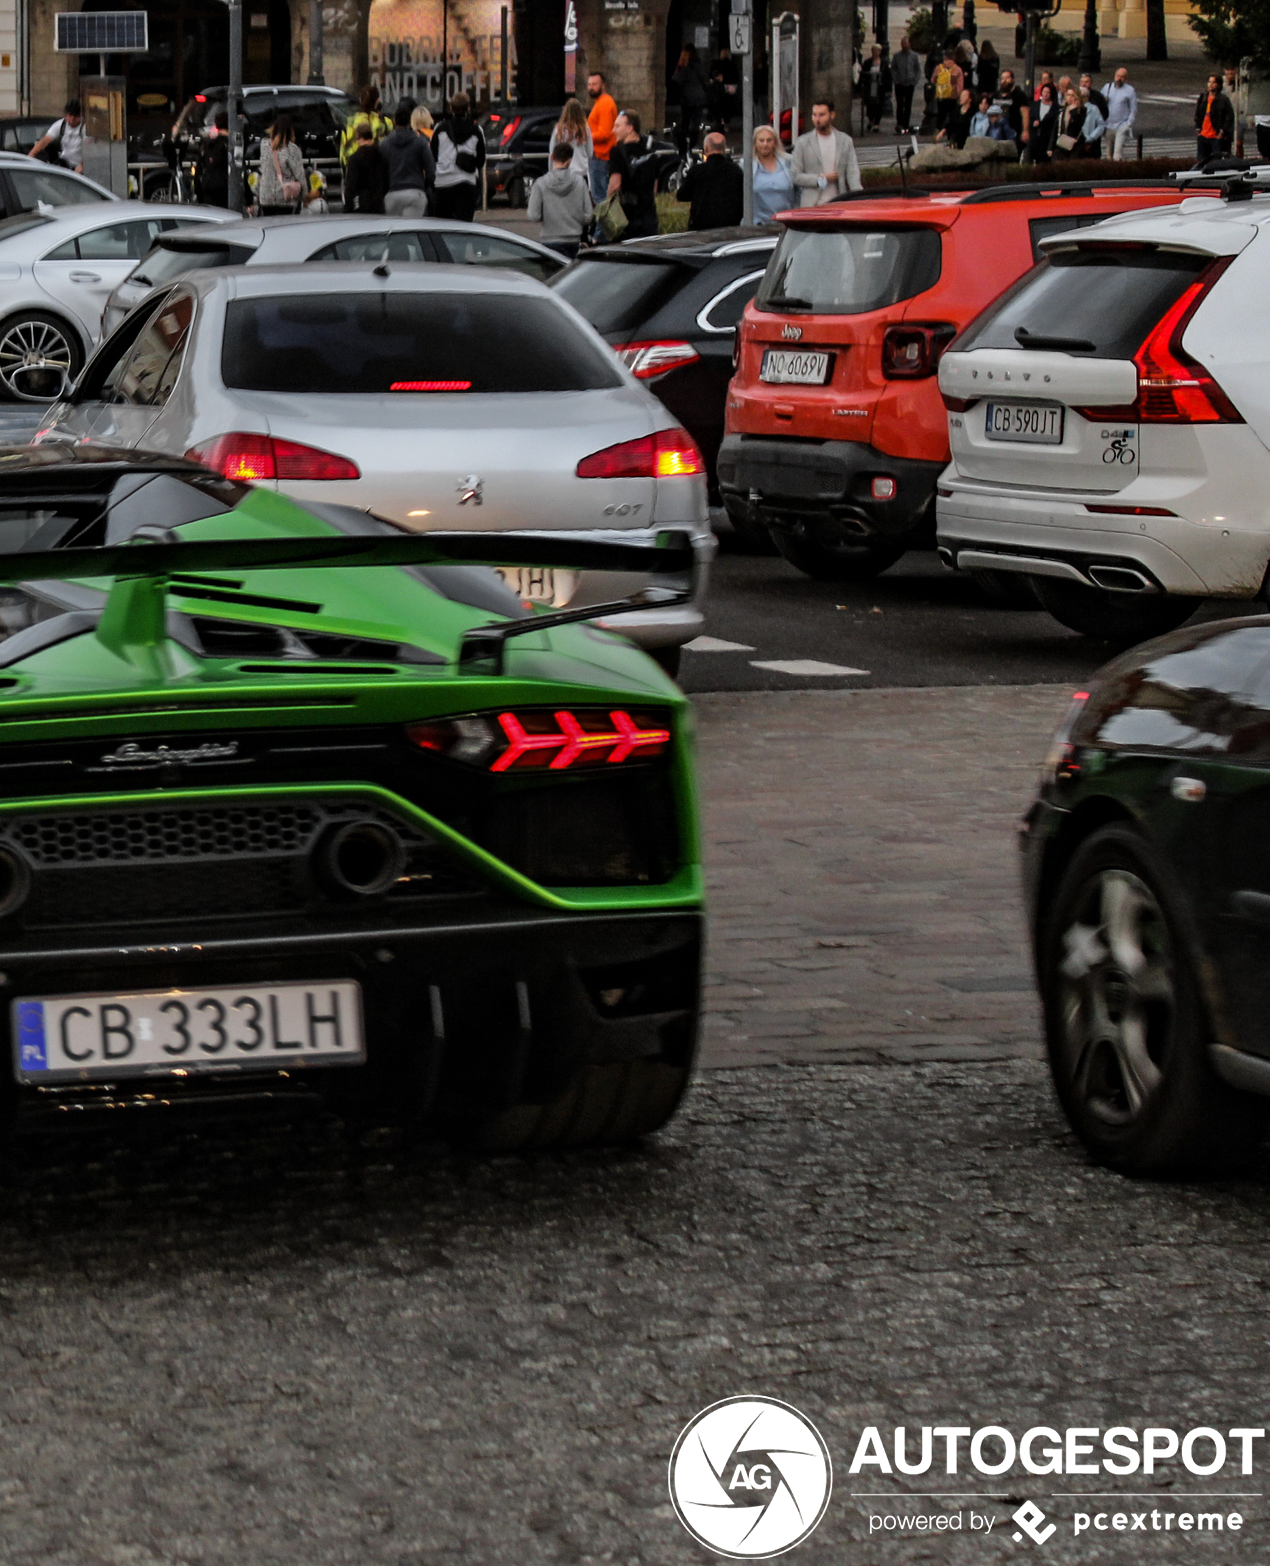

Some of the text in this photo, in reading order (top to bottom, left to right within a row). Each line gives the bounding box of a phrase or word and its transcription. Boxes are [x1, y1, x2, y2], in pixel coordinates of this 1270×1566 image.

[369, 34, 518, 66] BUBBLE TEA
[370, 70, 518, 102] AND COFFEE
[782, 324, 802, 340] Jeep
[787, 355, 825, 377] 6069V
[972, 370, 1051, 383] VOLVO
[994, 407, 1057, 435] CB 590JT
[602, 502, 644, 516] 607
[60, 990, 344, 1062] CB 333LH
[22, 1045, 46, 1062] PL
